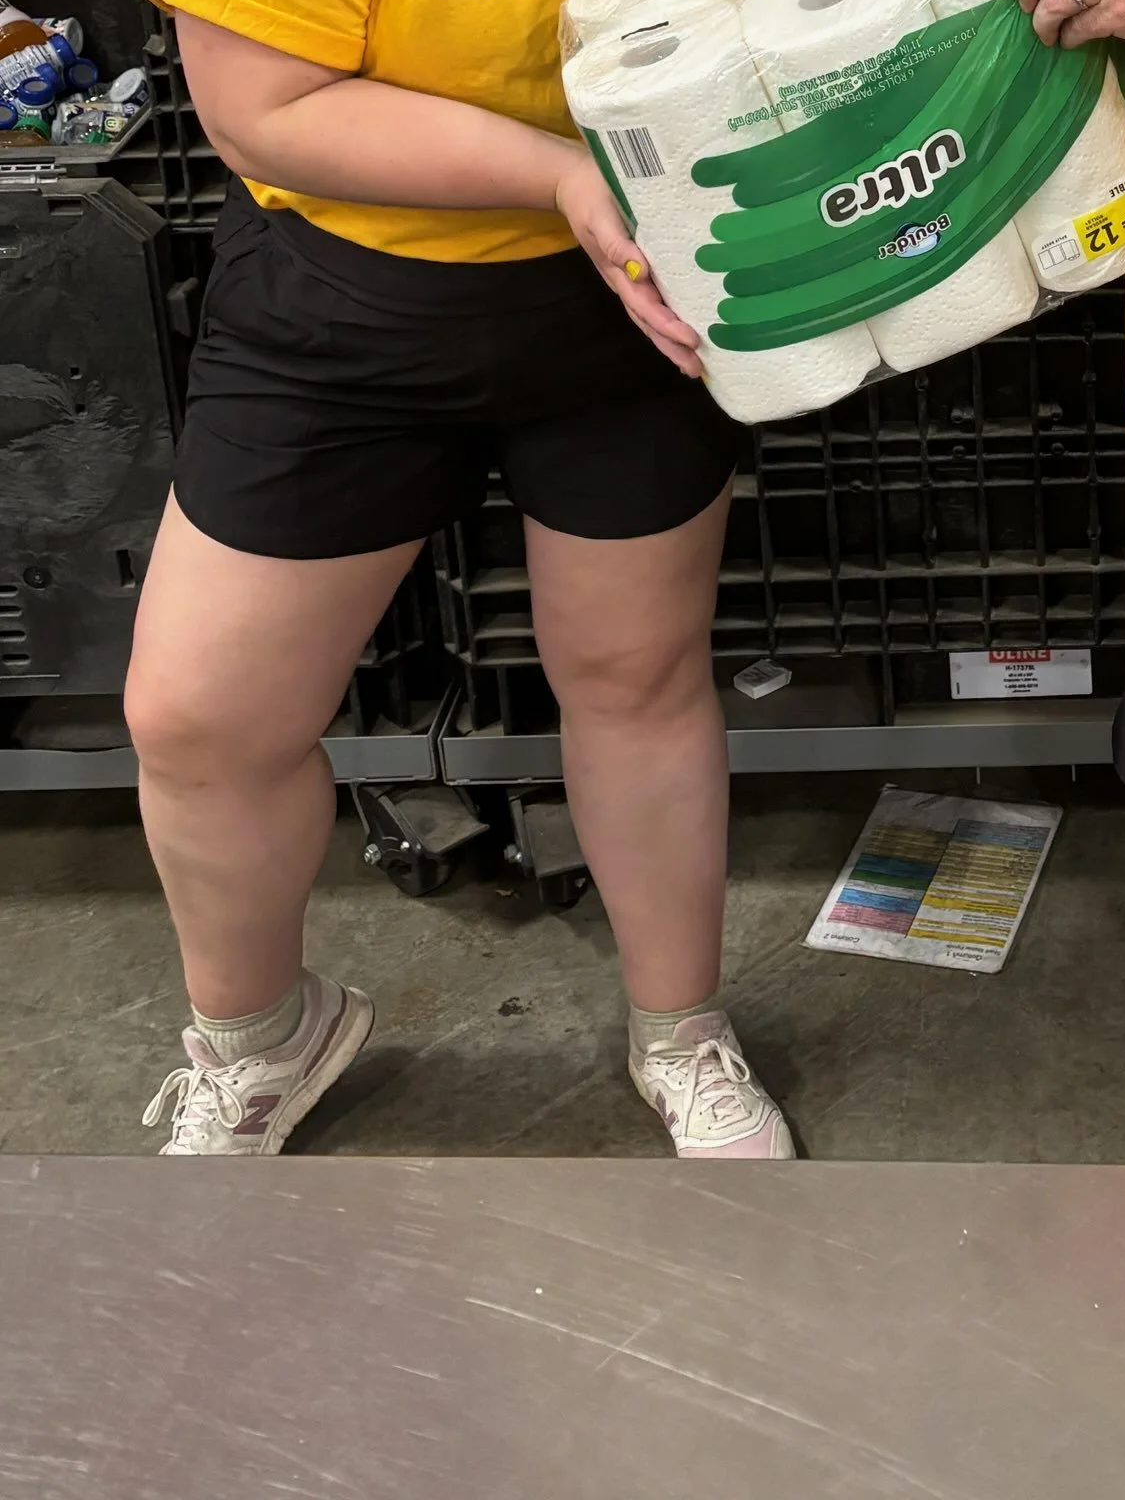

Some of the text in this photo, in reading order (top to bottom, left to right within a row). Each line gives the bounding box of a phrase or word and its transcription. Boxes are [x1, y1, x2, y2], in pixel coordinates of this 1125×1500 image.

[961, 27, 977, 41] 120
[866, 57, 877, 70] IN
[901, 47, 936, 69] SHEETS
[859, 70, 882, 87] ROLL
[883, 62, 901, 76] PER
[800, 88, 827, 108] TOTAL
[803, 68, 915, 119] 6 ROLLS PAPER TOWELS
[823, 131, 964, 225] ultra
[878, 214, 951, 259] Boulder
[1085, 222, 1119, 253] 12
